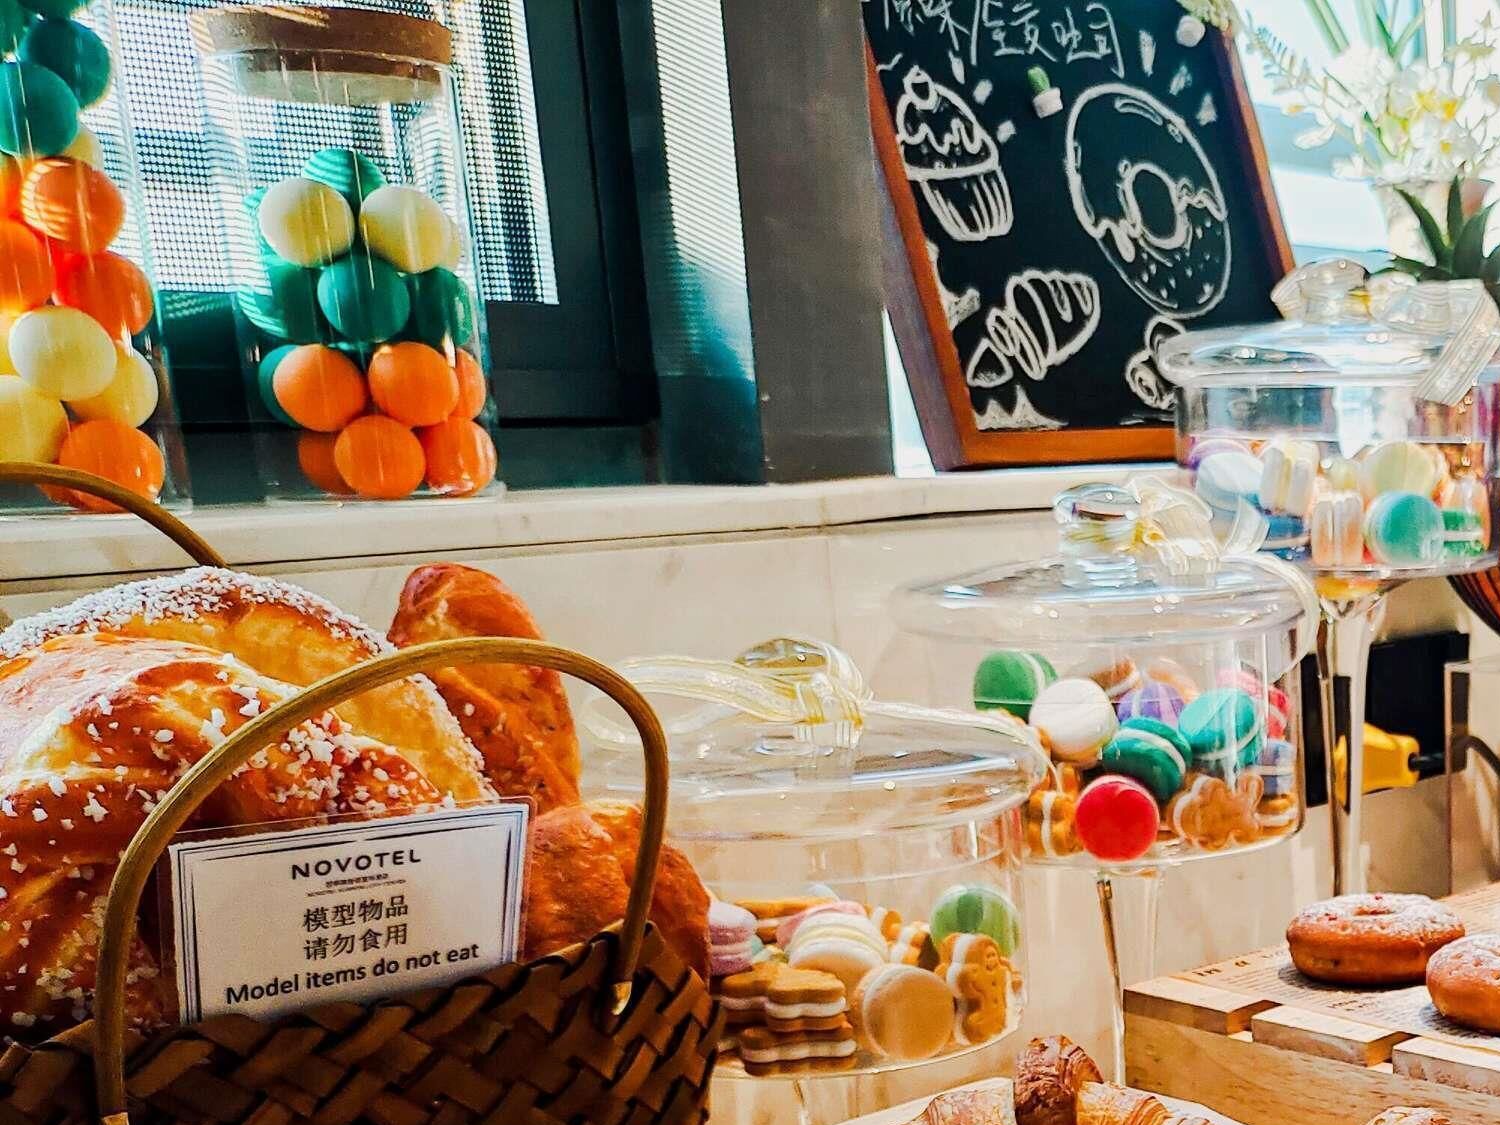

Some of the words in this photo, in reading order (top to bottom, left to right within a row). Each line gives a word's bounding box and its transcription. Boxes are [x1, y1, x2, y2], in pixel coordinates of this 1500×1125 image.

[291, 849, 421, 880] NOVOTEL
[303, 895, 409, 933] 模型物品
[303, 923, 408, 962] 请勿食用
[226, 974, 299, 1005] Model
[306, 962, 366, 990] items
[372, 958, 400, 976] do
[405, 949, 441, 971] not
[446, 944, 480, 962] eat
